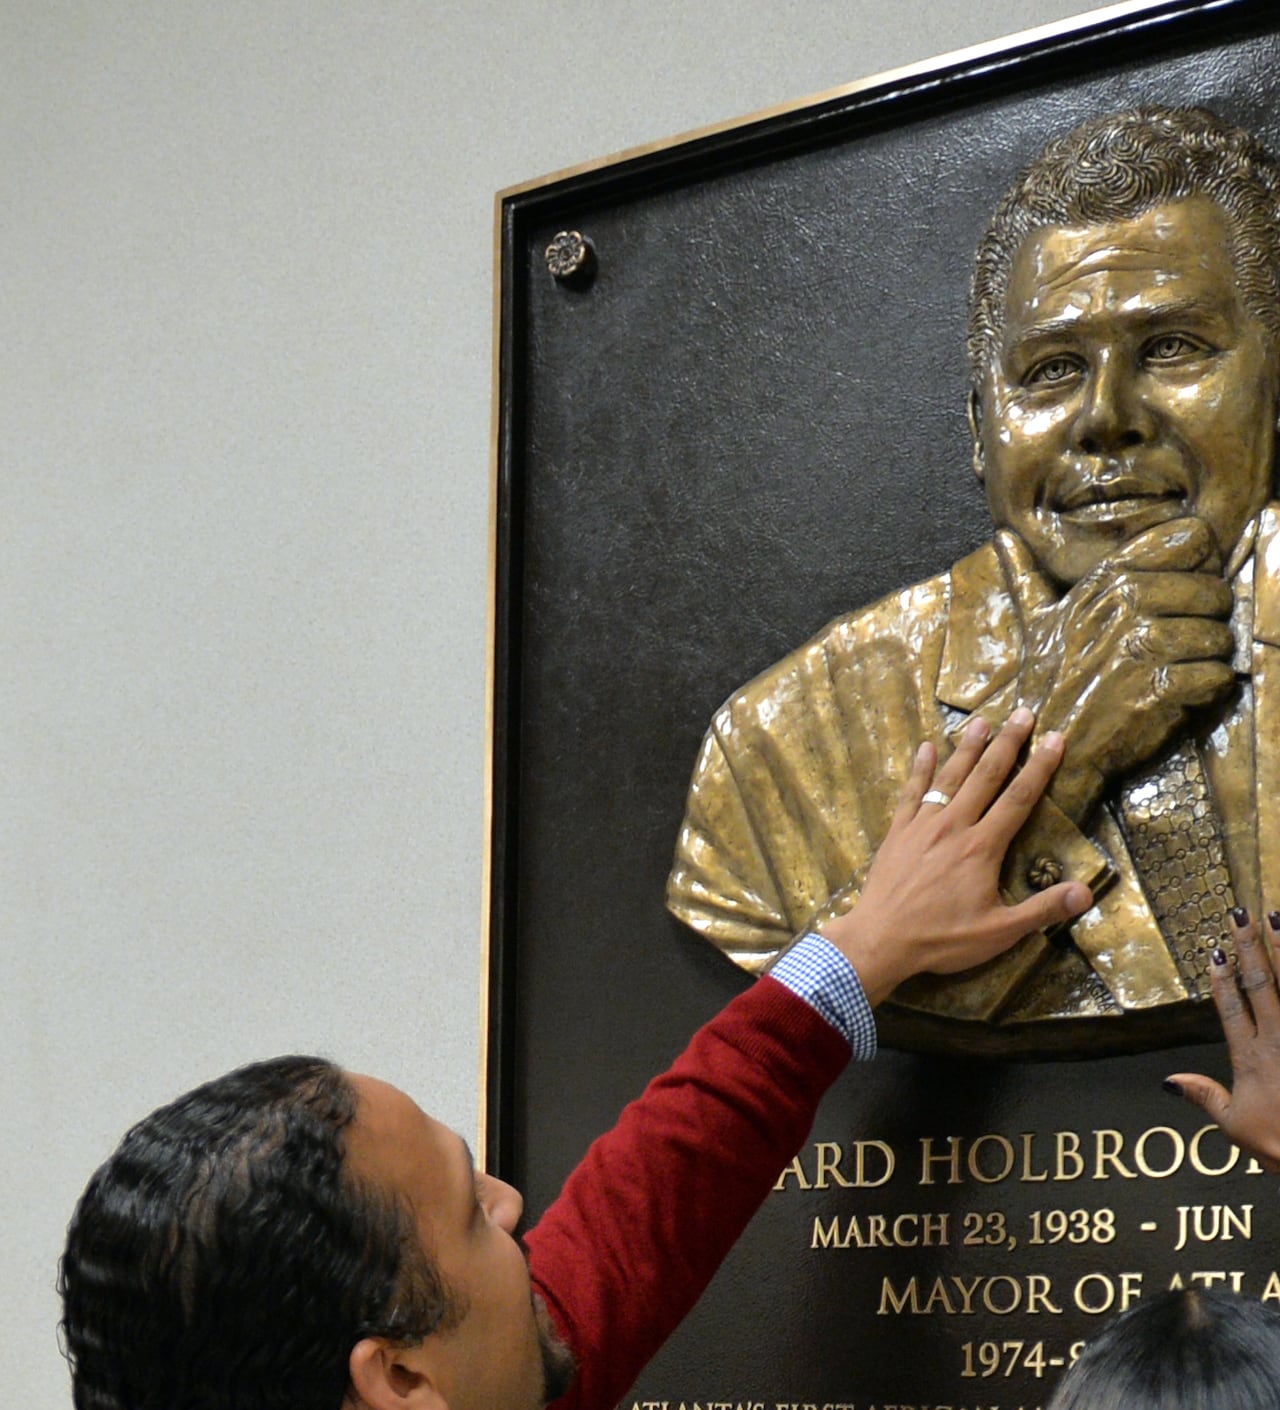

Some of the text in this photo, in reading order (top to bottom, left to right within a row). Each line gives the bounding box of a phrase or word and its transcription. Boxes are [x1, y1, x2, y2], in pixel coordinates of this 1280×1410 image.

[919, 1124, 1263, 1186] HOLBROO
[811, 1213, 949, 1249] MARCH
[963, 1211, 1017, 1250] 23,
[1029, 1208, 1116, 1244] 1938
[877, 1273, 1063, 1314] MAYOR
[1074, 1272, 1143, 1314] OF
